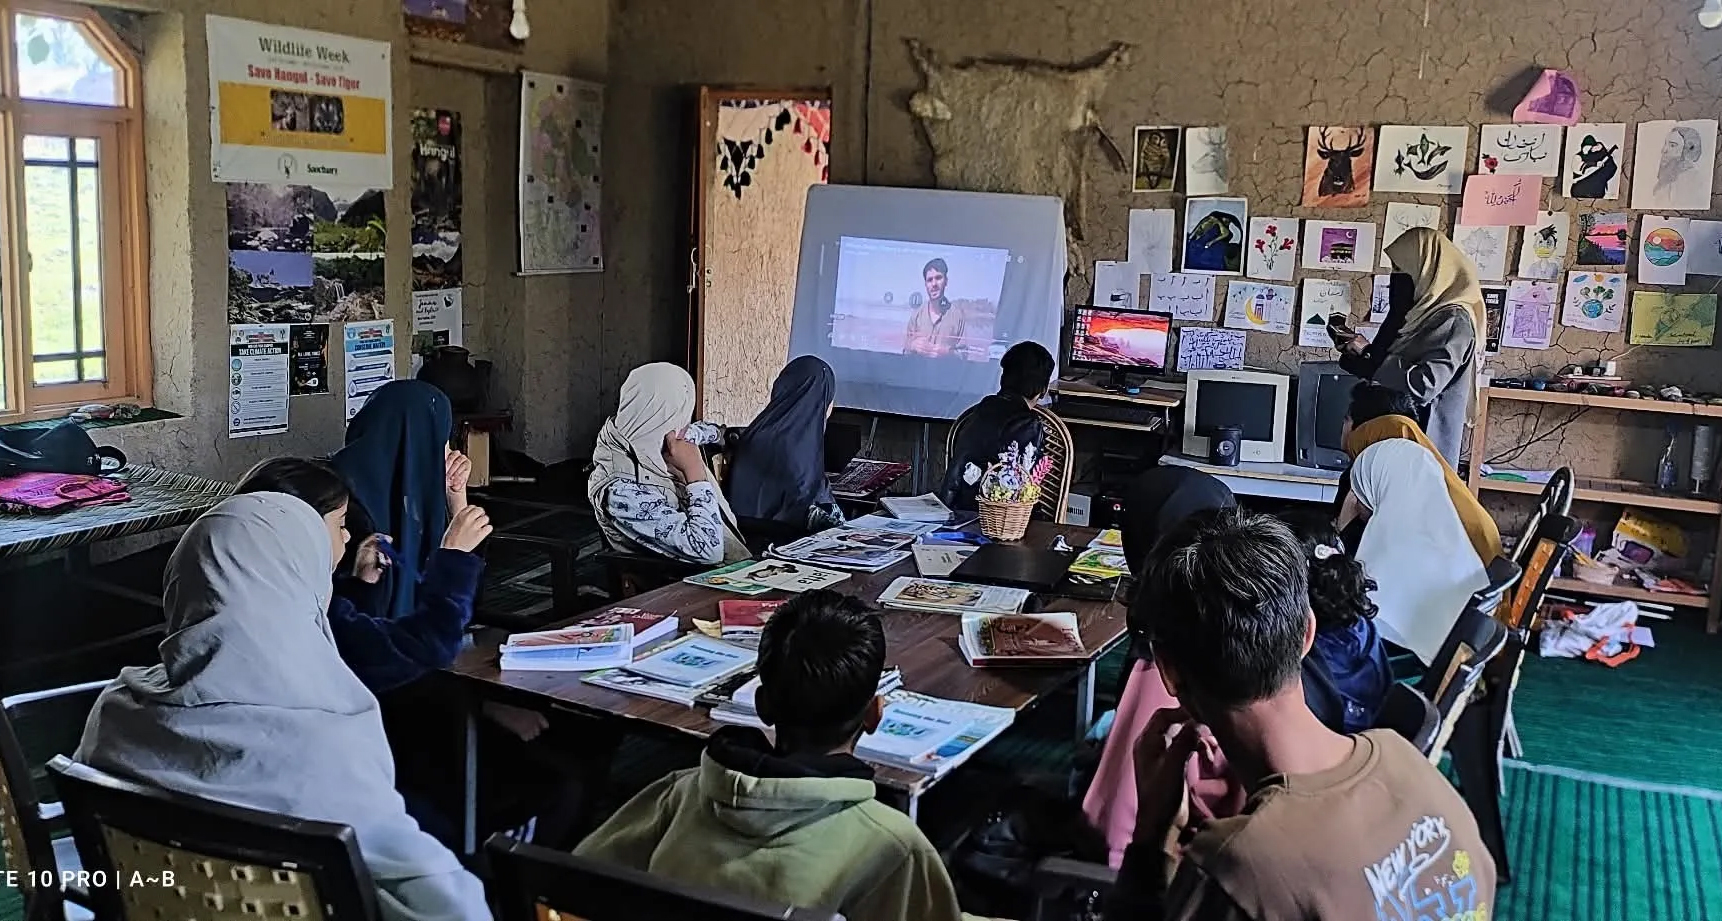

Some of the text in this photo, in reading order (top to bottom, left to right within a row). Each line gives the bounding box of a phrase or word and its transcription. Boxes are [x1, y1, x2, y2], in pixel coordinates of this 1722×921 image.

[259, 36, 351, 64] Wildlife Week
[248, 64, 272, 80] Save
[315, 72, 338, 87] Save
[306, 164, 339, 176] Sanctuary
[249, 347, 267, 355] CLIMATE
[1364, 842, 1407, 908] NEW
[1402, 815, 1451, 886] YORK
